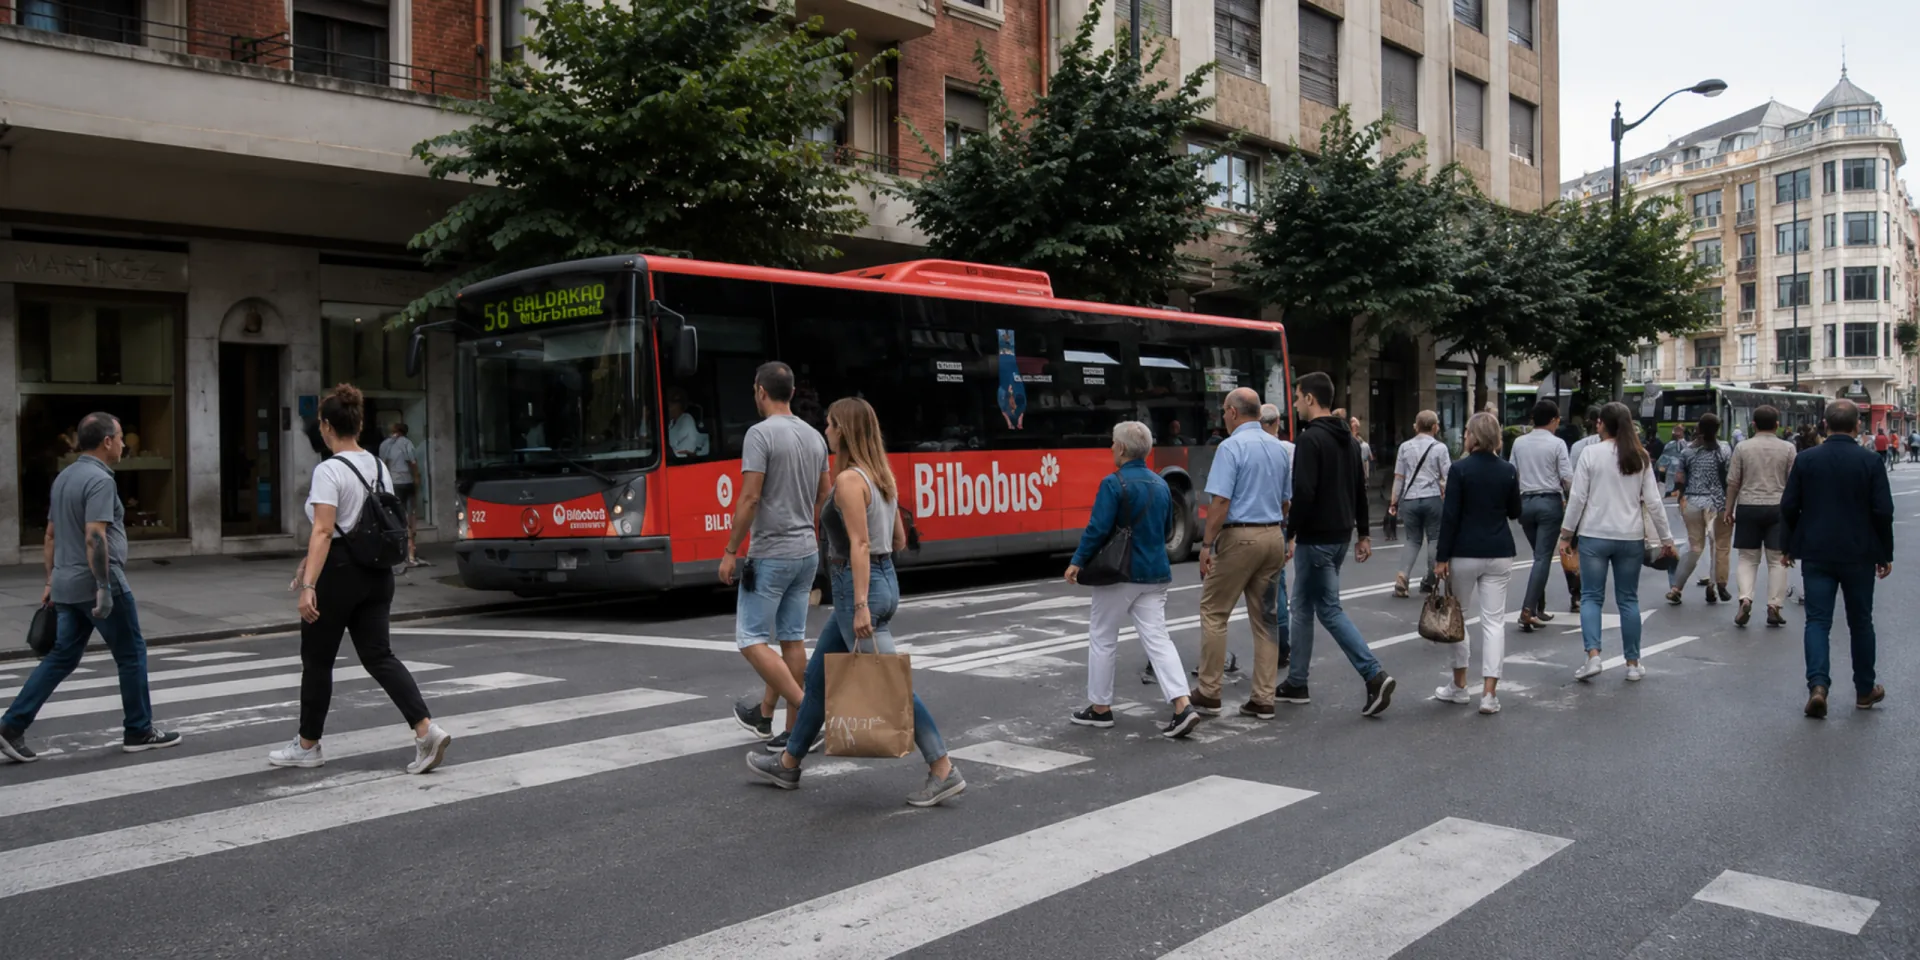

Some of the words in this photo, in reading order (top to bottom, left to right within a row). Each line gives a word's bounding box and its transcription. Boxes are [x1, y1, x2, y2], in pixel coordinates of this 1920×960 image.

[513, 284, 605, 313] GALDAKAO
[484, 301, 509, 332] 56
[914, 460, 1043, 518] Bilbobus
[704, 513, 735, 532] BILR
